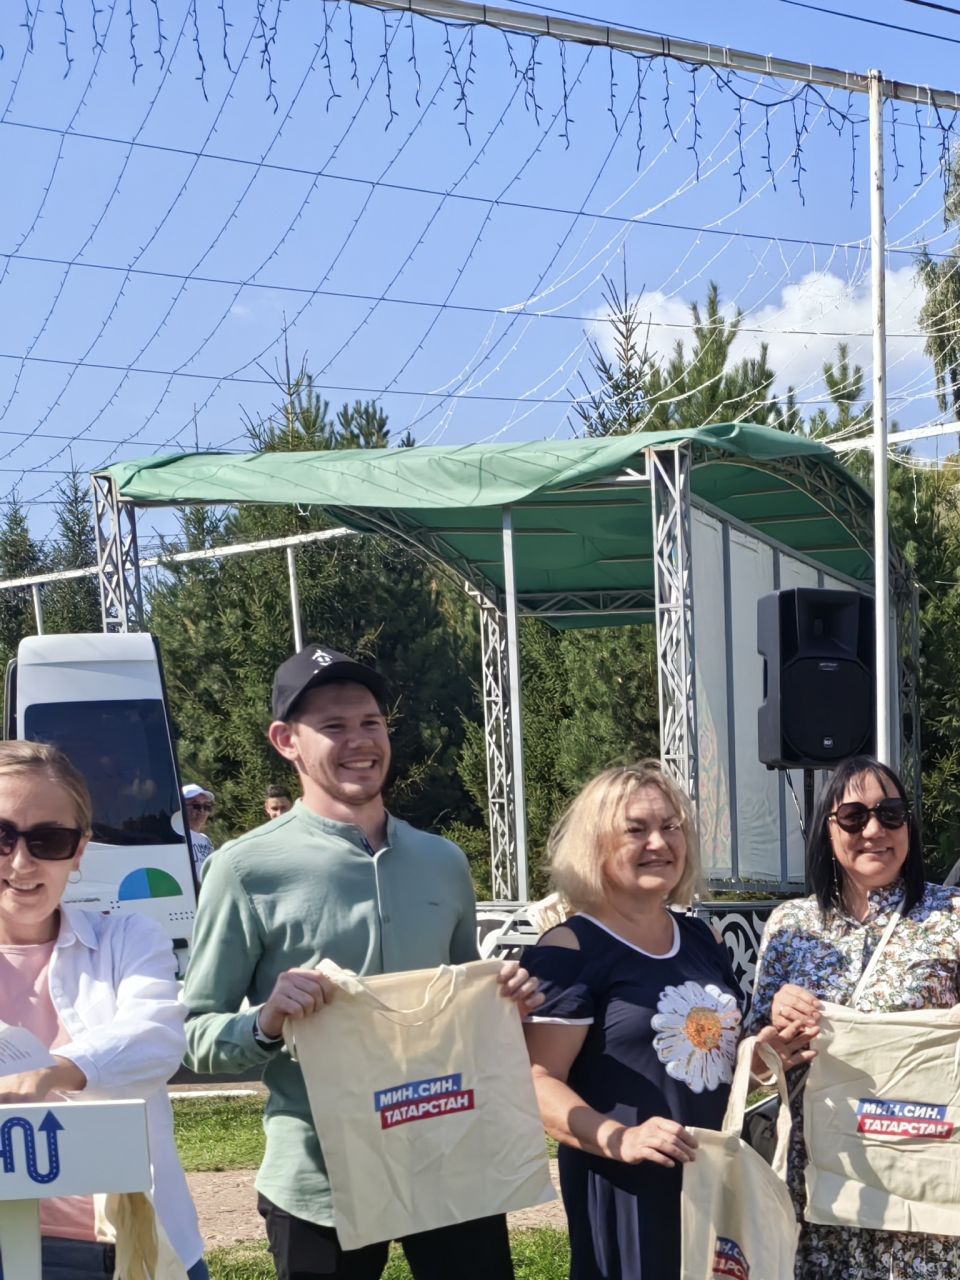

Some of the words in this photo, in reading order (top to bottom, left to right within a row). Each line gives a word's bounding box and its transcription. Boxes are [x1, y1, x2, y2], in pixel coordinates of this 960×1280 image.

[380, 1079, 458, 1107] МИН.СИН.
[385, 1094, 469, 1125] ТАТАРСТАН
[862, 1102, 941, 1119] МИН.СИН.
[863, 1118, 950, 1136] ТАТАРСТАН
